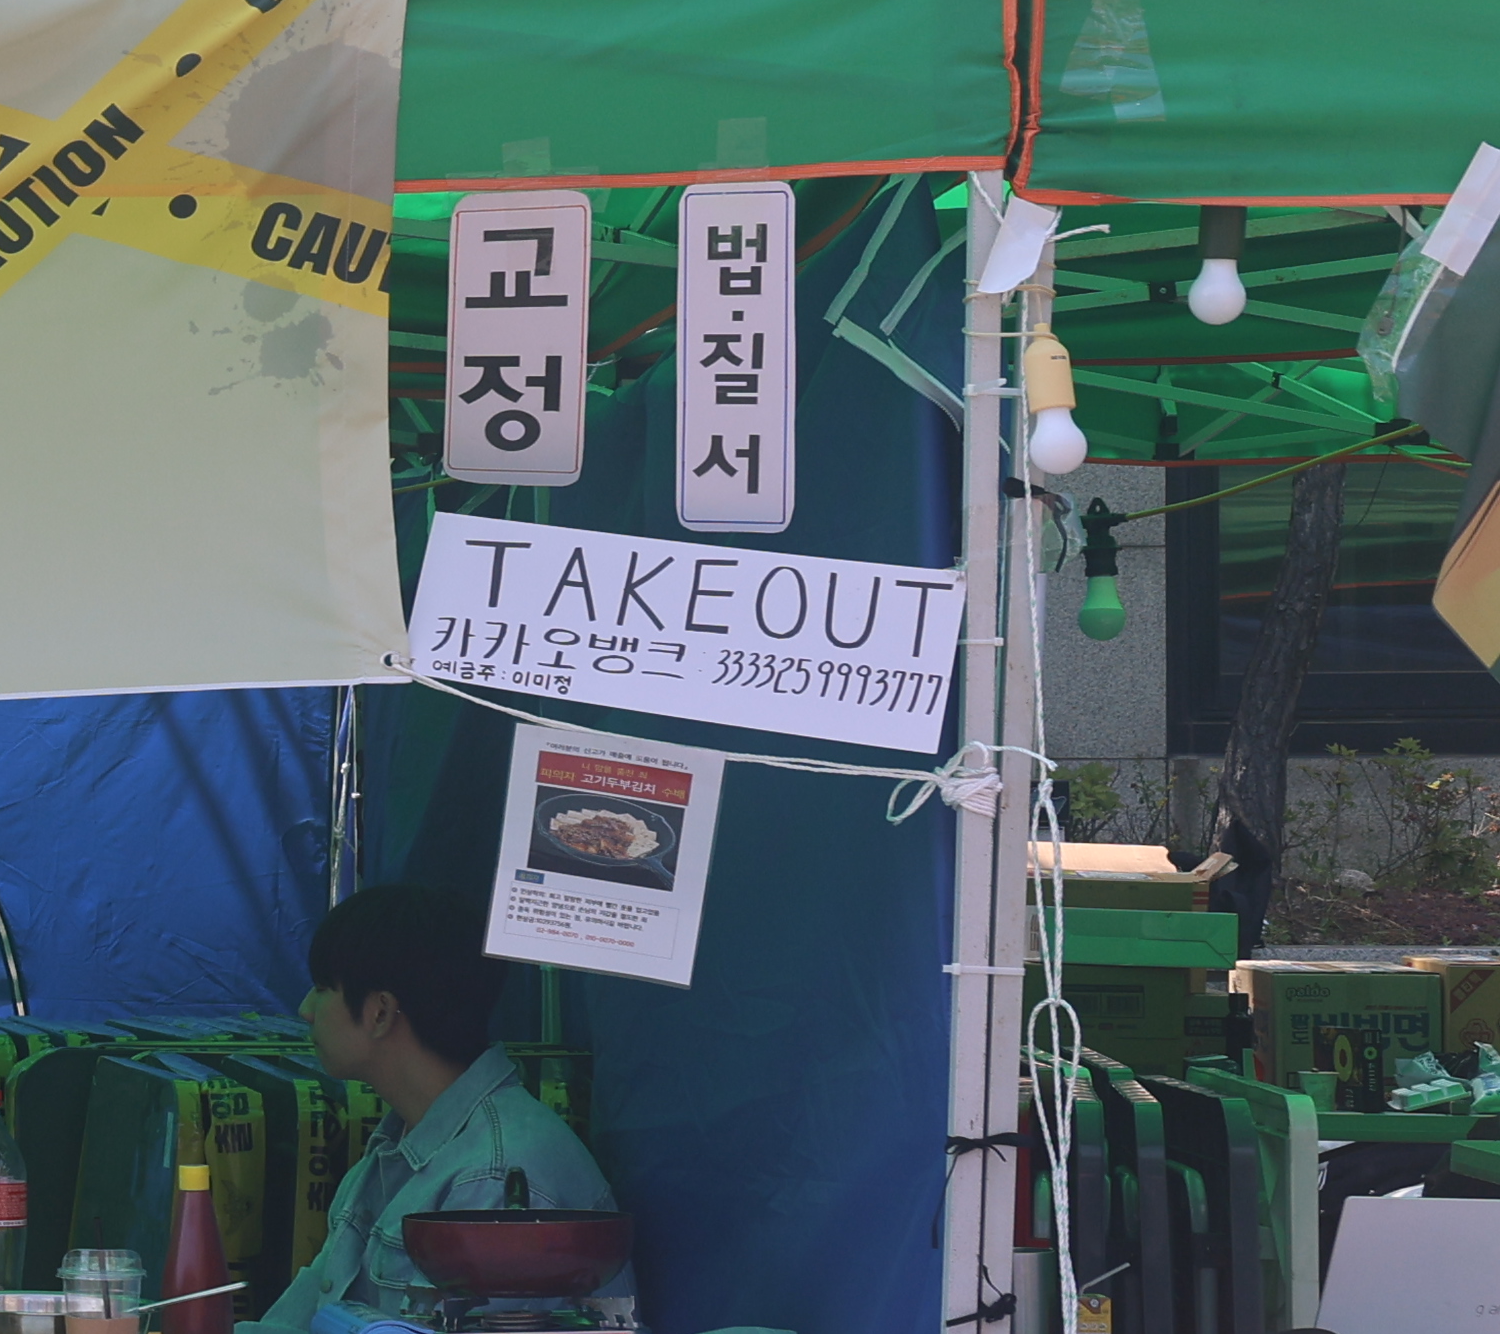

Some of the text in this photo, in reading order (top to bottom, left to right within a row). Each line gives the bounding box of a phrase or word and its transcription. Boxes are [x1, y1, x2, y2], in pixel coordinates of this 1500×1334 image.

[459, 226, 569, 453] 교정
[465, 539, 954, 658] TAKEOUT
[431, 616, 687, 680] 카카오뱅크
[541, 768, 686, 800] 피의자 고기두부김치 수배
[1285, 982, 1331, 1002] paldo
